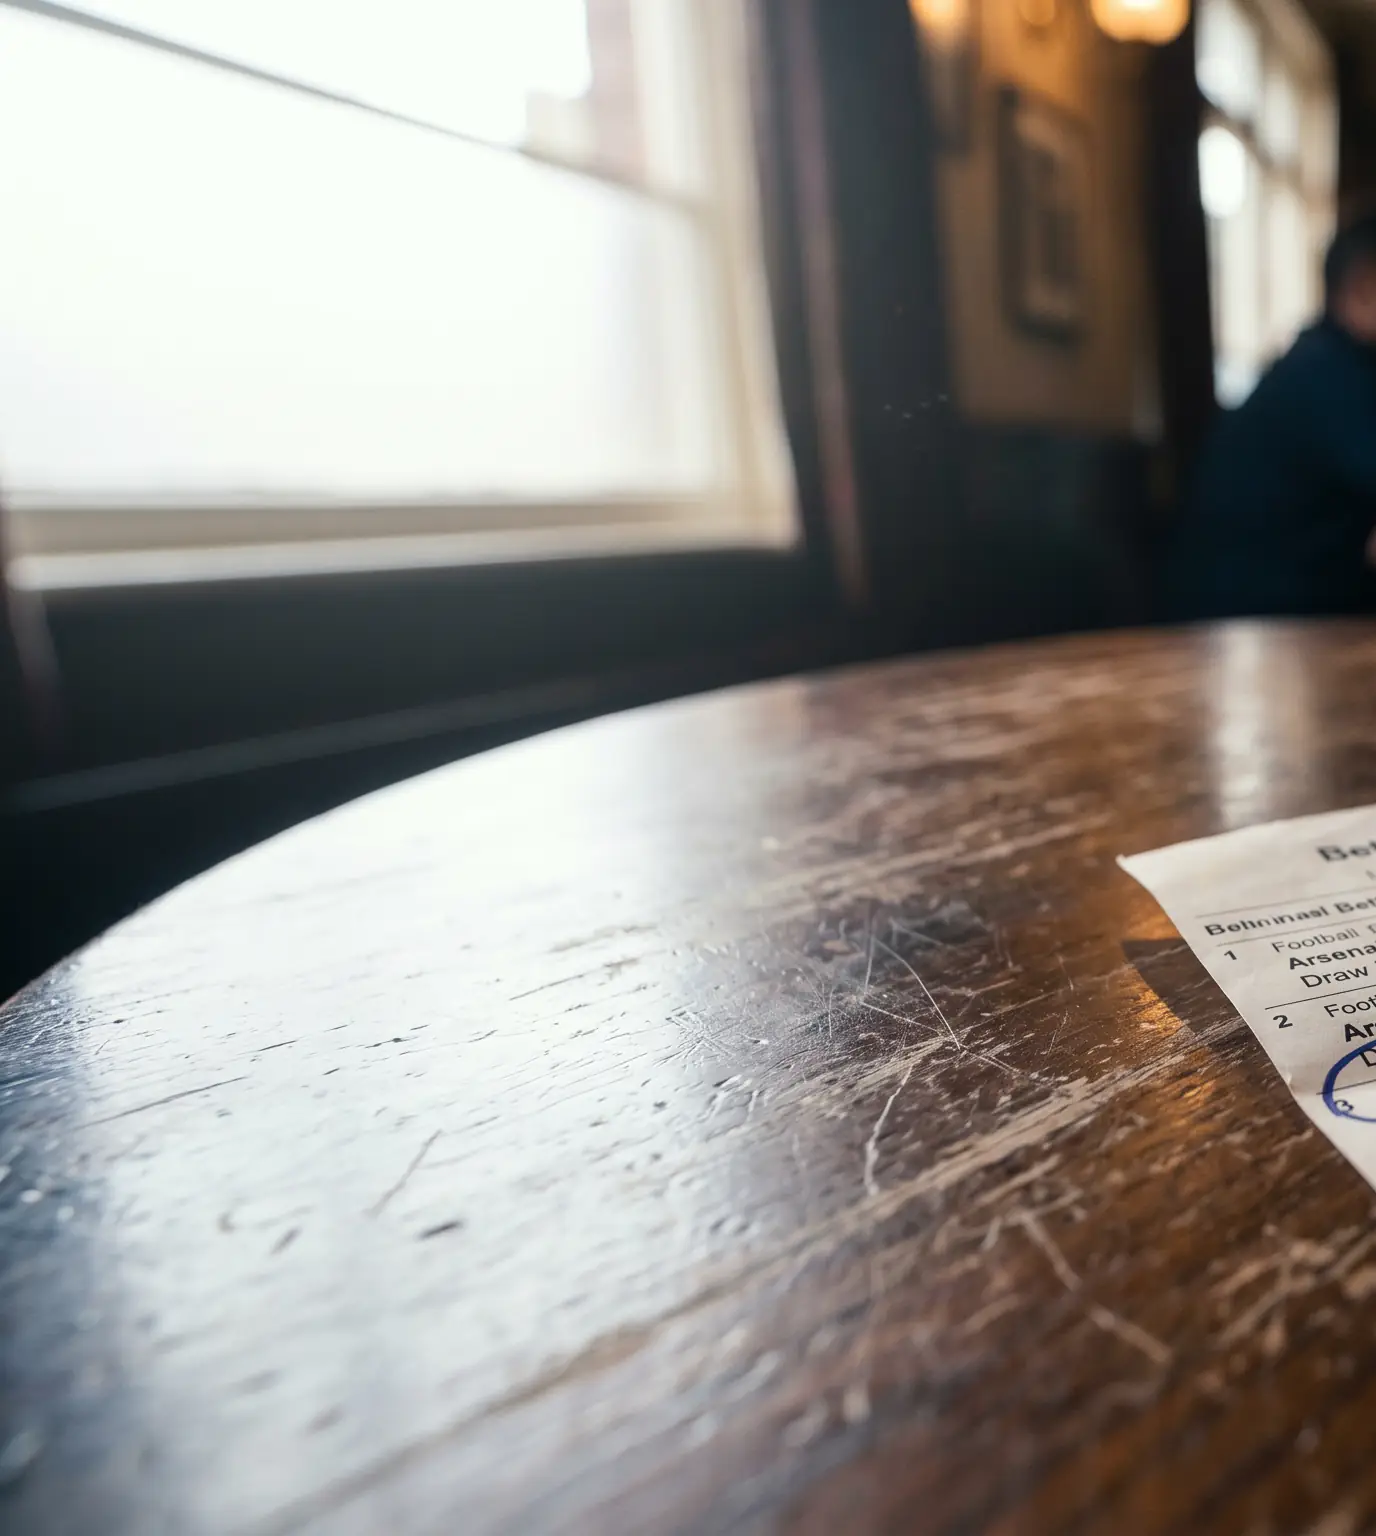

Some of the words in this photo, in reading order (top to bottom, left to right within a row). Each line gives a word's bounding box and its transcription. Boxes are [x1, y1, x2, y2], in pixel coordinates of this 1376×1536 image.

[1271, 927, 1361, 954] Football
[1300, 965, 1369, 989] Draw
[1273, 1014, 1293, 1029] 2
